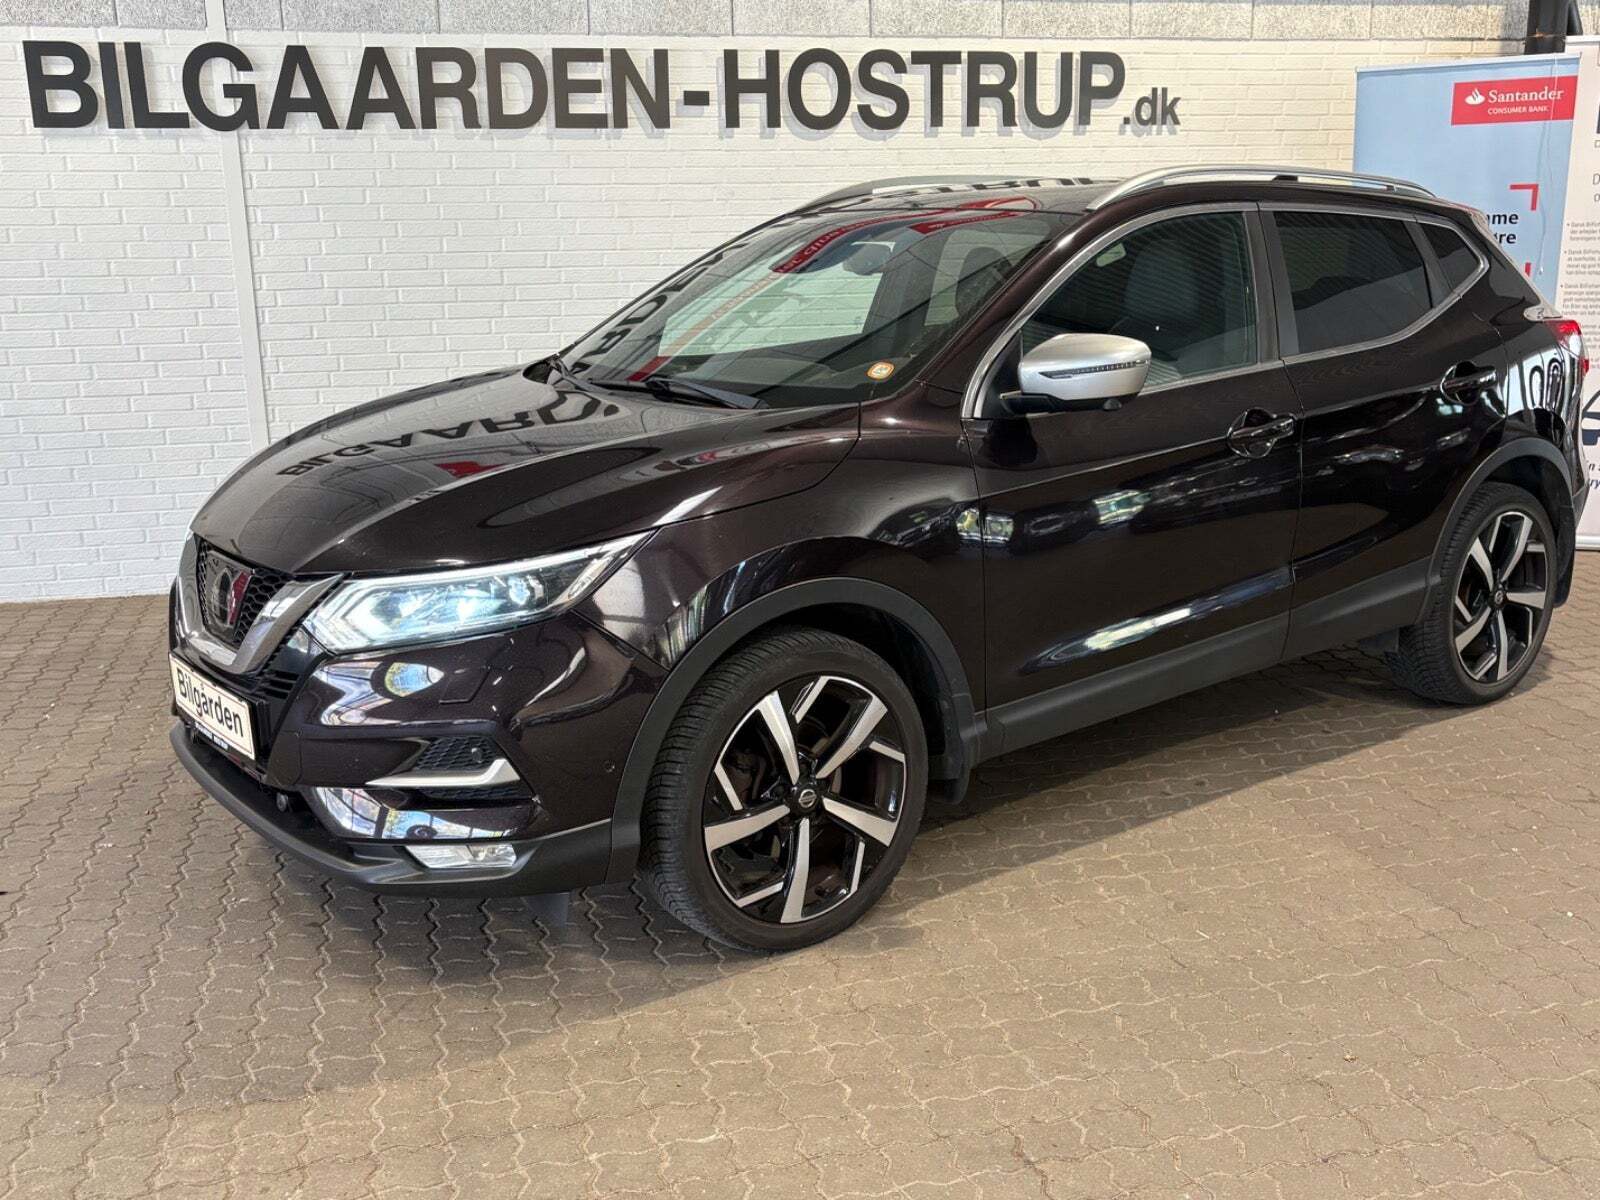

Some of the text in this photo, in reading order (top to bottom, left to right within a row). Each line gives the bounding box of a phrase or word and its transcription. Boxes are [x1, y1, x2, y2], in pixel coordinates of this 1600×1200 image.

[1488, 86, 1564, 103] Santander
[1488, 105, 1548, 115] CONSUMER BANK
[1487, 213, 1519, 225] me
[177, 668, 244, 737] Bilgården
